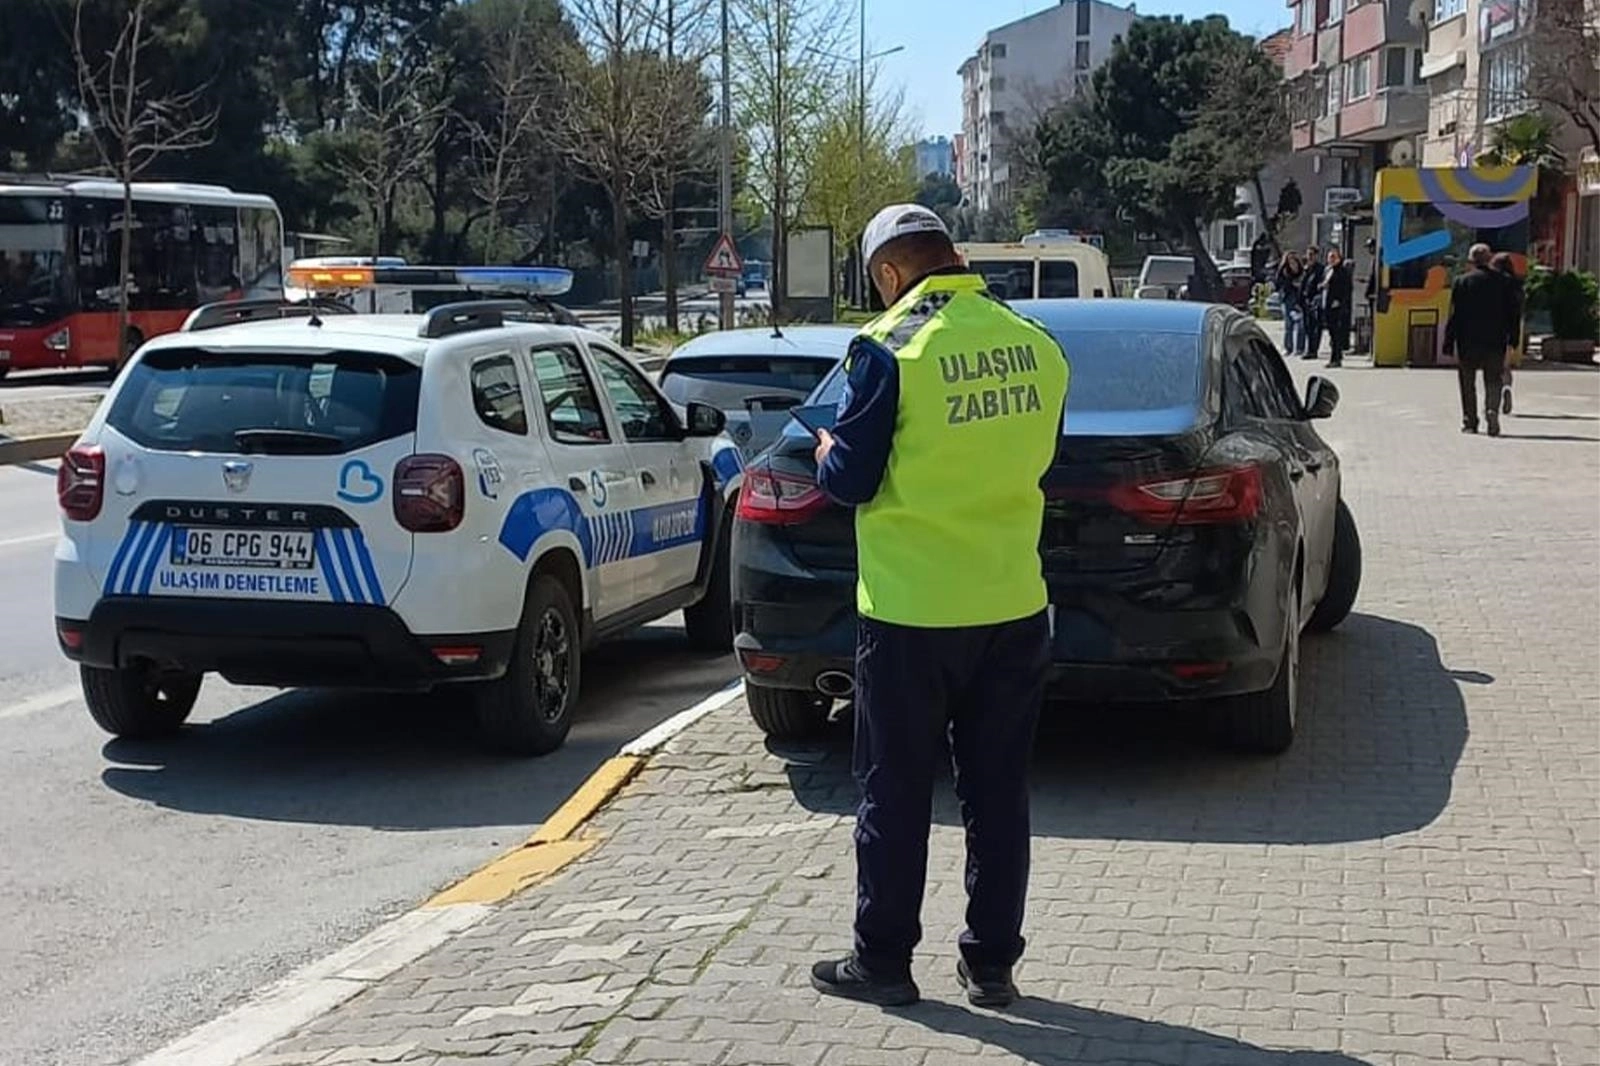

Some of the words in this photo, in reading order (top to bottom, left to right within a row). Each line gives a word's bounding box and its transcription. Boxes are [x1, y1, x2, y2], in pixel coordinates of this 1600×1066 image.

[939, 344, 1038, 383] ULAŞIM
[945, 384, 1041, 424] ZABITA
[166, 506, 307, 522] DUSTER
[188, 532, 212, 556] 06
[223, 533, 262, 557] CPG
[269, 534, 308, 559] 944
[160, 570, 219, 592] ULAŞIM
[224, 573, 319, 594] DENETLEME
